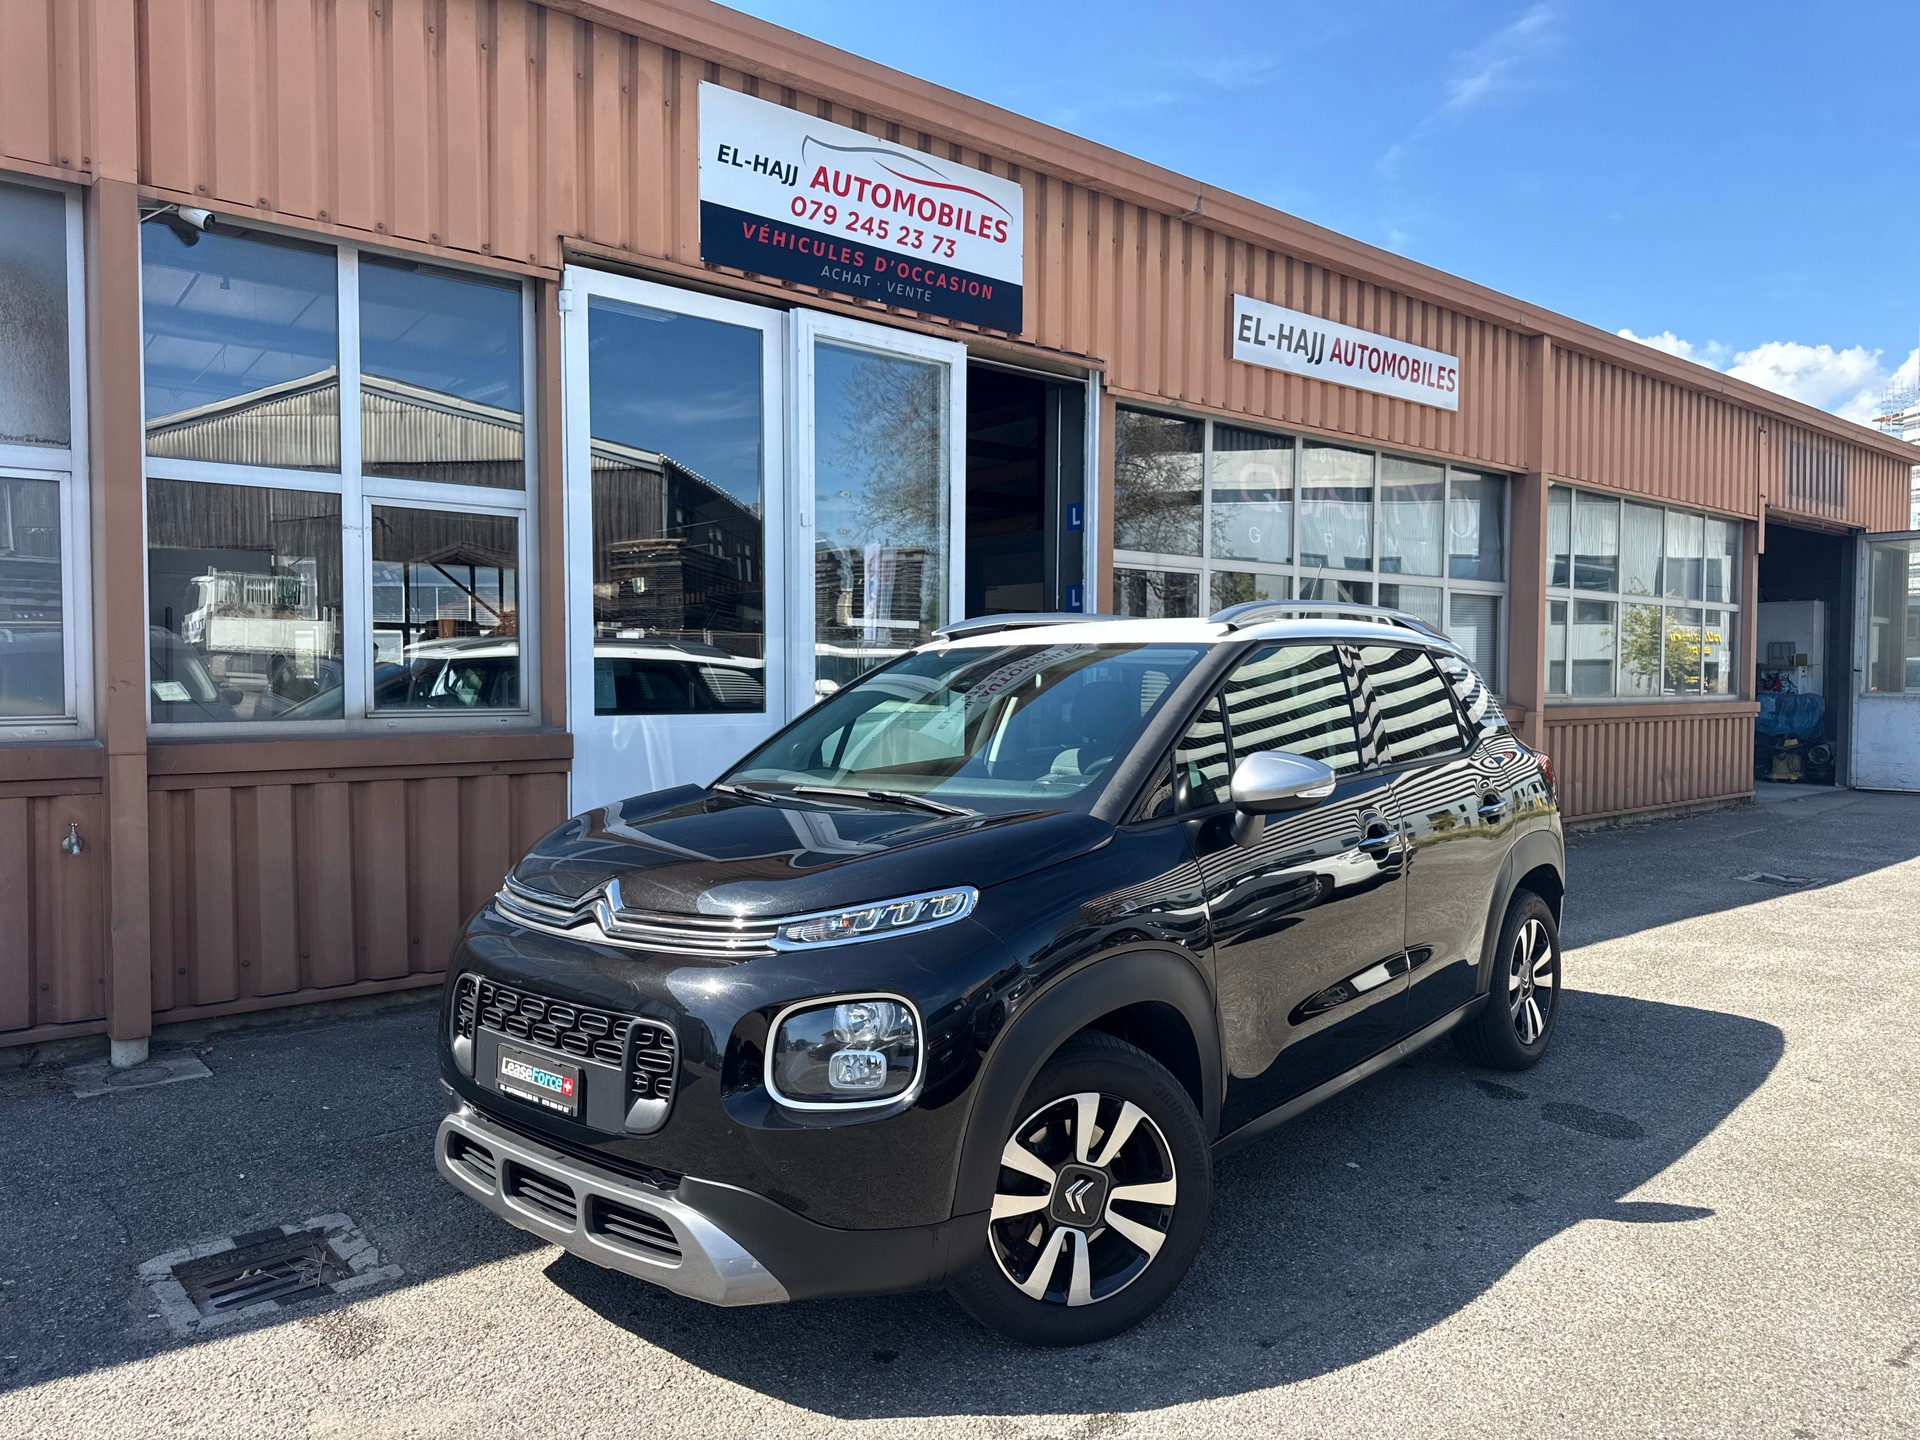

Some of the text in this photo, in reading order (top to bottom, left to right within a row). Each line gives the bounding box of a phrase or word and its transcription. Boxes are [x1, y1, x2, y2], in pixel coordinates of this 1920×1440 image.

[716, 143, 1009, 244] EL-HAJJ AUTOMOBILES
[790, 196, 957, 258] 079 245 23 73
[742, 222, 994, 300] VÉHICULES D'OCCASION
[820, 265, 932, 303] ACHAT VENTE
[1238, 313, 1456, 393] EL-HAJJ AUTOMOBILES
[1072, 507, 1081, 526] L
[1071, 589, 1080, 607] L
[501, 1057, 563, 1090] LeaseForce
[1151, 1081, 1206, 1184] BRIDGESTONE
